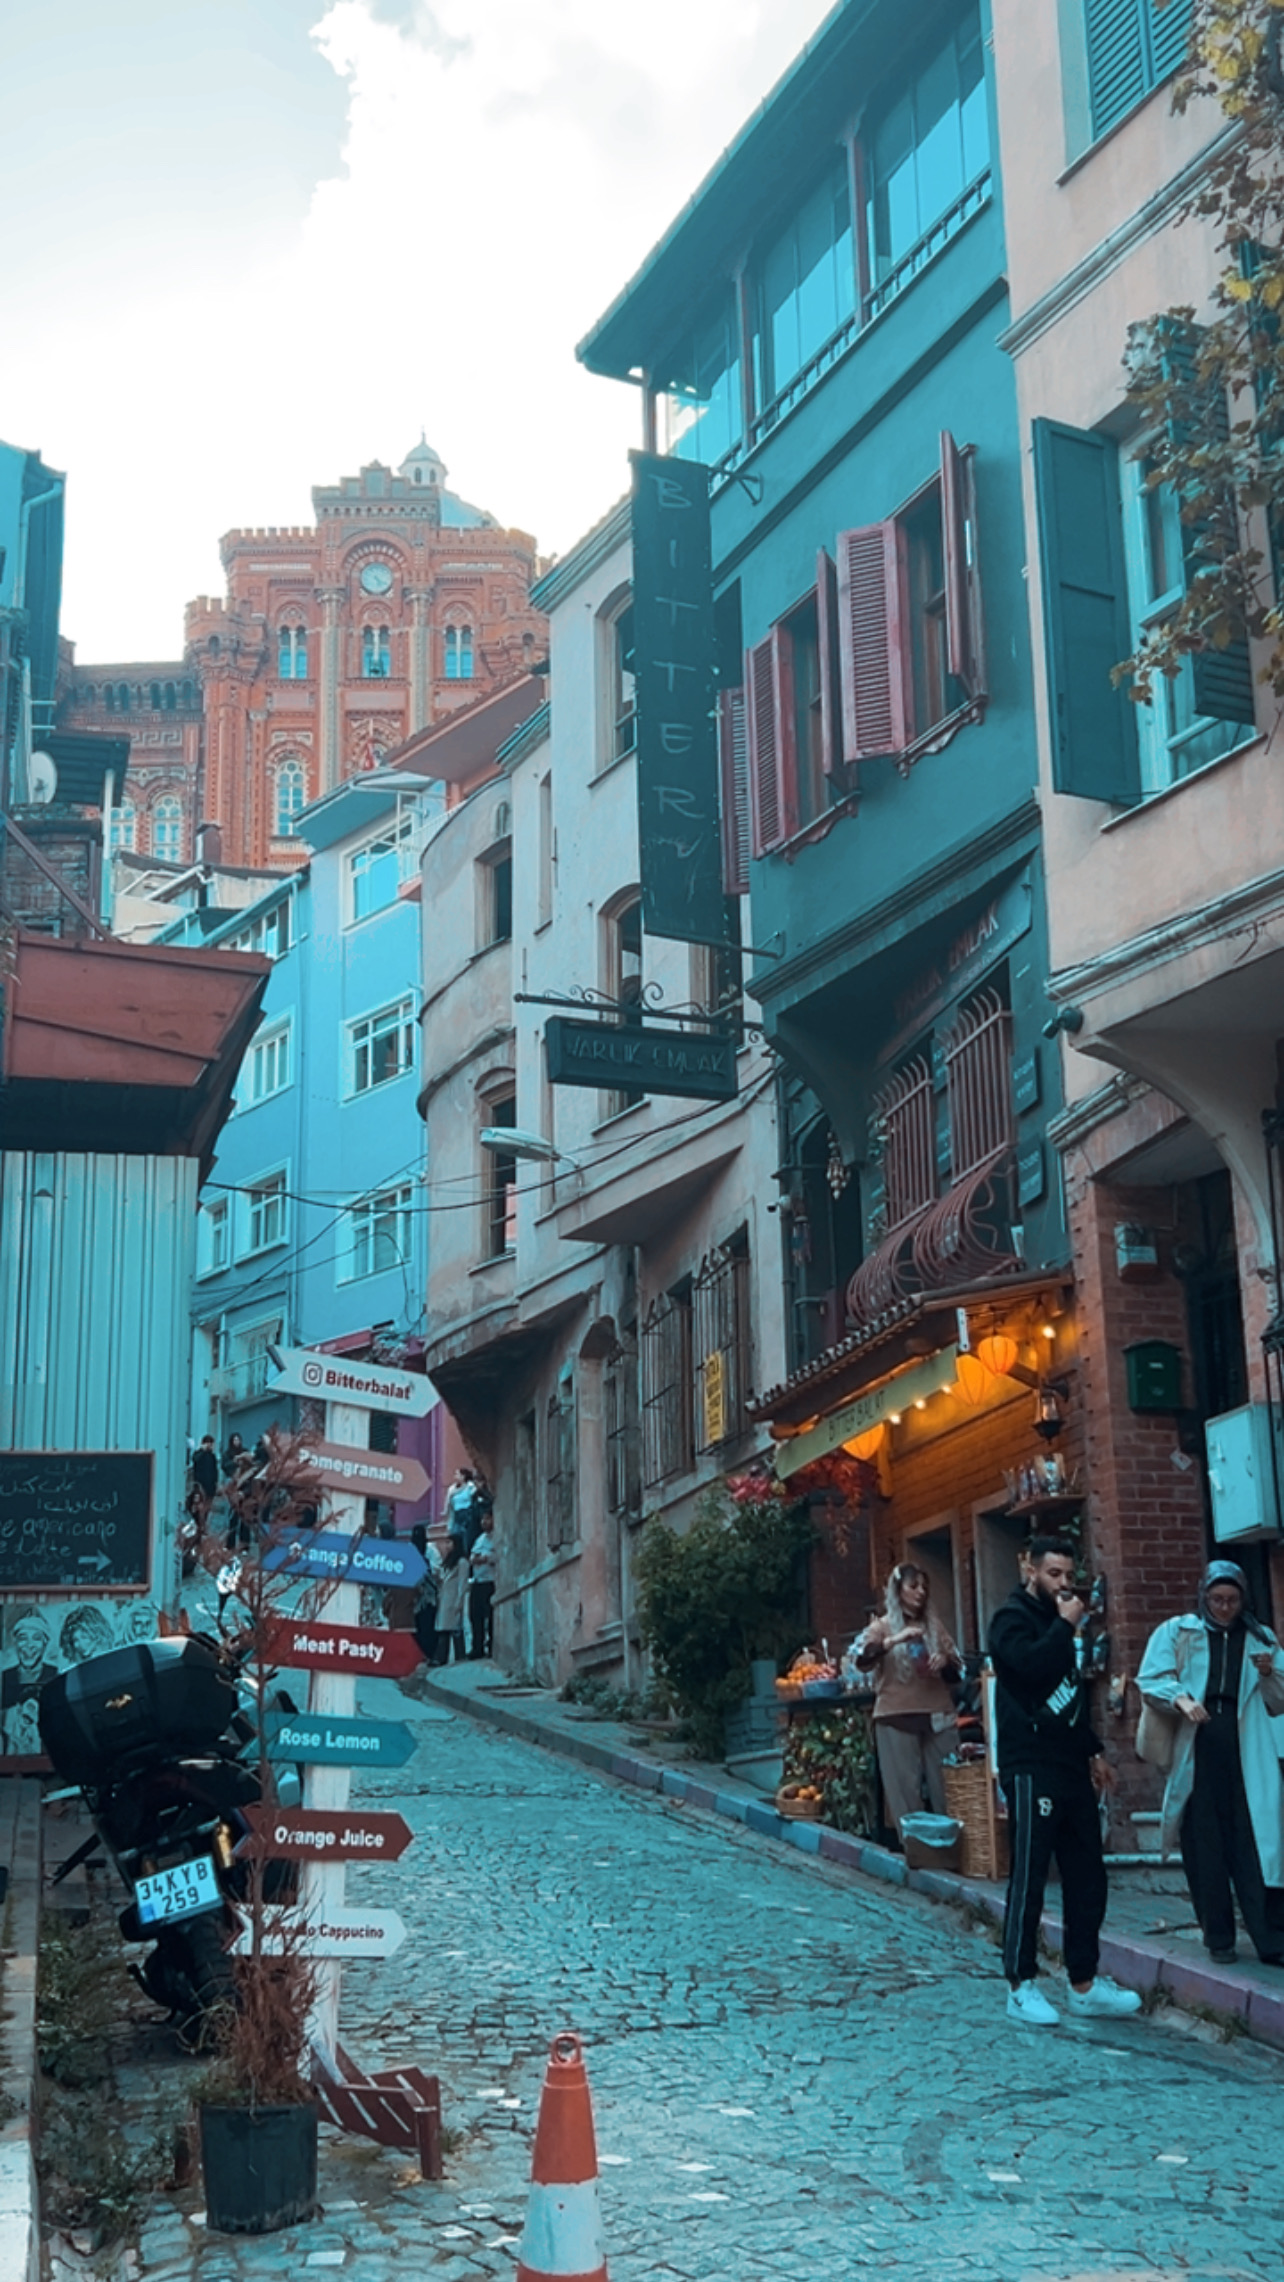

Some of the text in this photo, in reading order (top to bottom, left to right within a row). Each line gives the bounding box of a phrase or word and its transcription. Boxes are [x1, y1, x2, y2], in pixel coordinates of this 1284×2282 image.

[326, 1370, 412, 1400] Bitterbalat
[352, 1550, 404, 1575] Coffee
[293, 1634, 384, 1663] Meat Pasty
[279, 1727, 380, 1751] Rose Lemon
[274, 1826, 385, 1850] Orange Juice
[162, 1886, 200, 1915] 259
[320, 1923, 385, 1942] Cappucino
